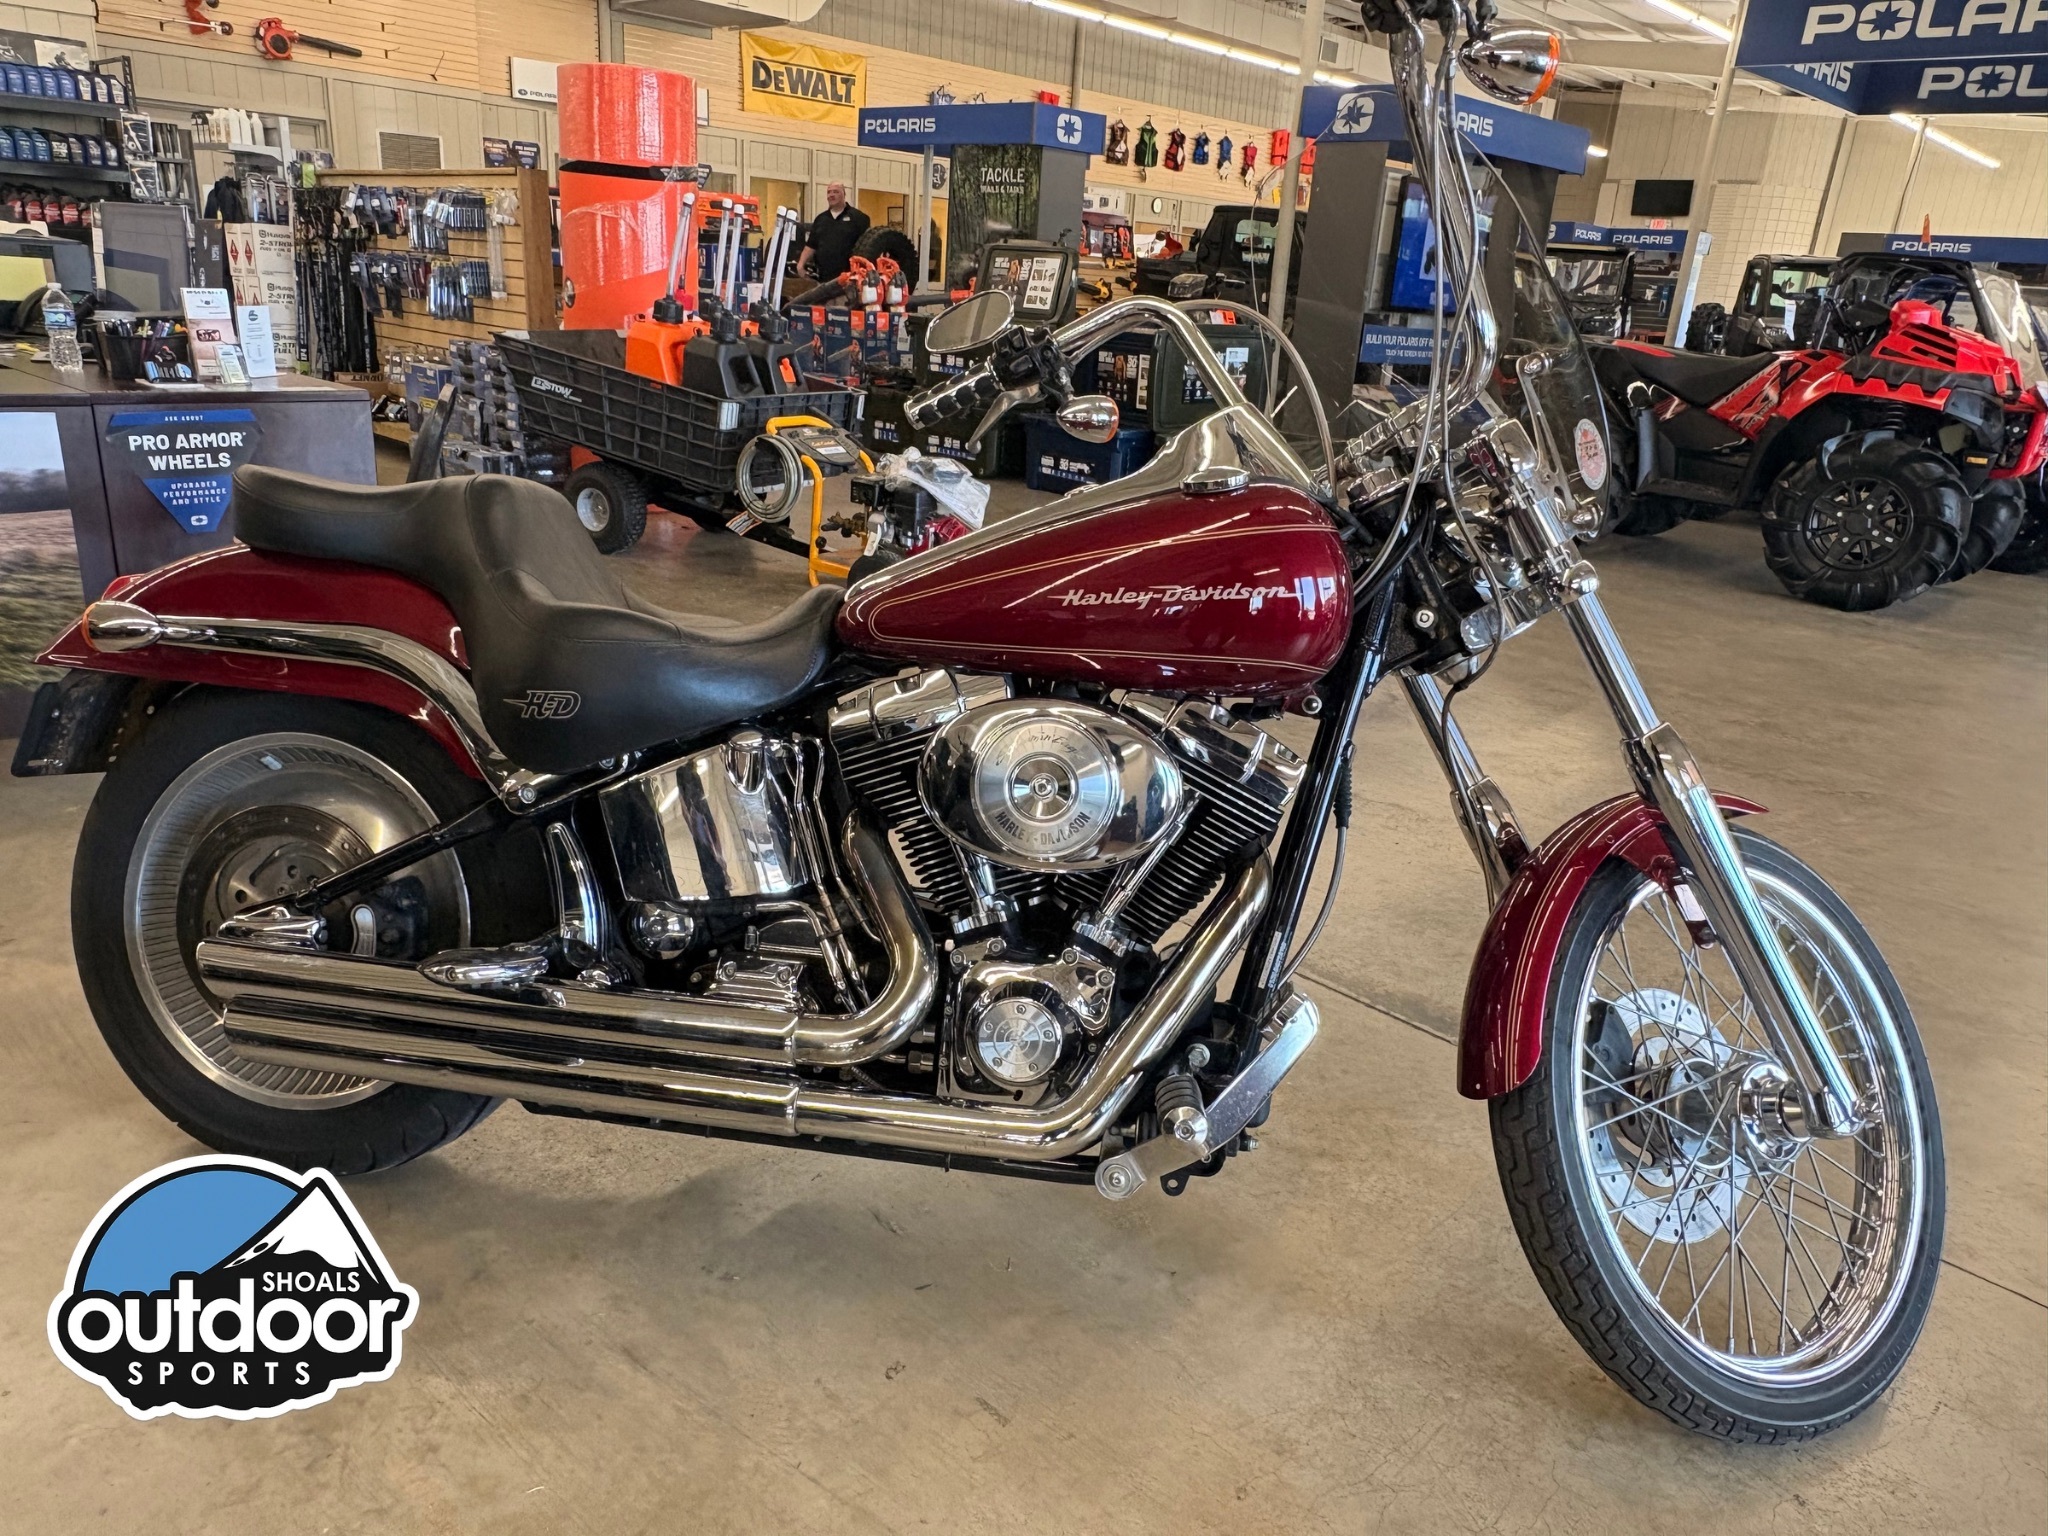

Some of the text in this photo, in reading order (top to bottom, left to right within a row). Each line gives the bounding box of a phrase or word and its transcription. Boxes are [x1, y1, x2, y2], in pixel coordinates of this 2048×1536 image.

[864, 117, 936, 134] POLARIS
[981, 167, 1025, 183] TACKLE
[1575, 228, 1601, 241] POLARIS
[1612, 234, 1673, 245] POLARIS
[1891, 240, 1972, 253] POLARIS
[1366, 334, 1382, 344] BUILD
[1383, 335, 1396, 345] YOUR
[1396, 335, 1418, 347] POLARIS
[128, 432, 243, 451] PRO ARMOR
[148, 452, 231, 471] WHEELS
[170, 480, 218, 490] UPGRADED
[163, 487, 227, 498] PERFORMANCE
[172, 496, 221, 506] AND STYLE
[1056, 582, 1291, 610] Harley-Davidson
